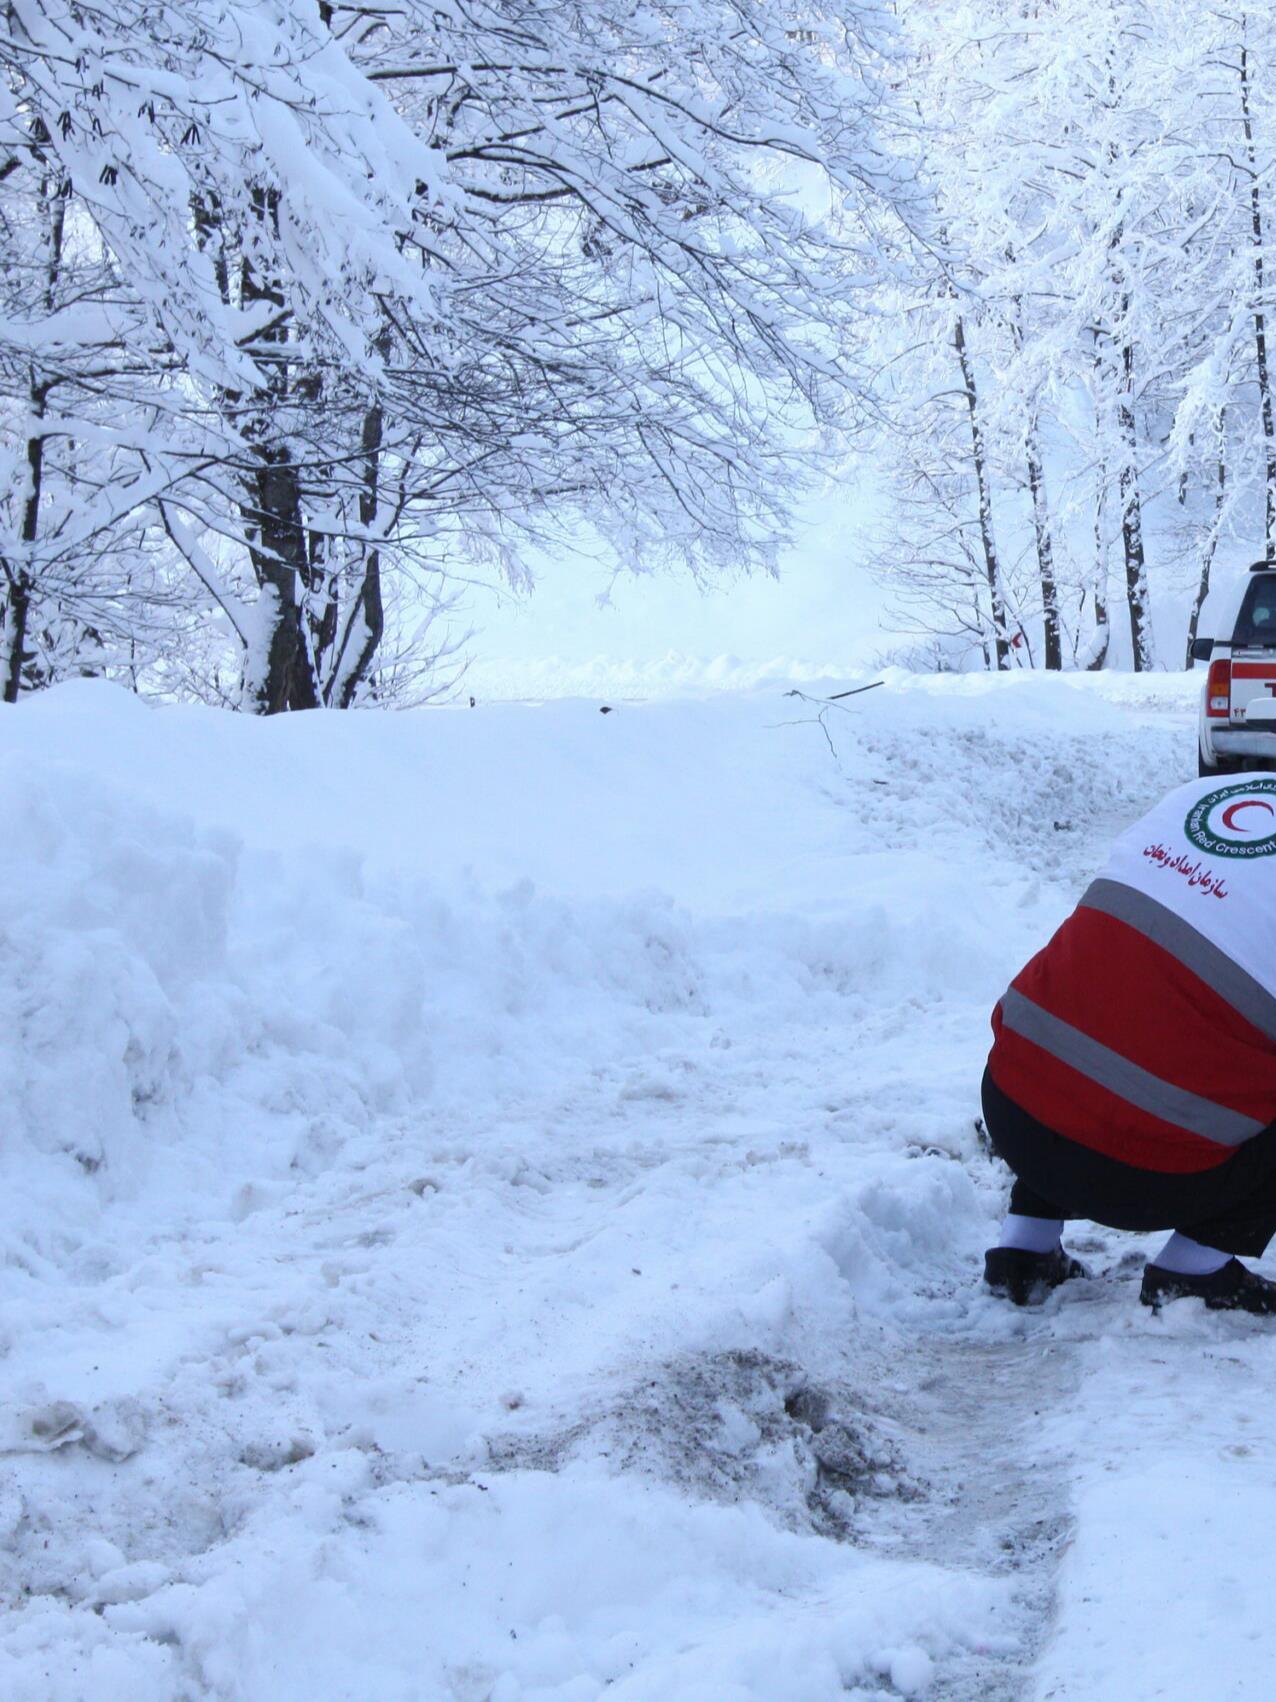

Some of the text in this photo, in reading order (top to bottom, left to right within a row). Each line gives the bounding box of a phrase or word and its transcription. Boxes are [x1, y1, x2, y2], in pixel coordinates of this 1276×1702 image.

[1190, 804, 1210, 832] Iranian
[1193, 831, 1217, 848] Red
[1169, 855, 1202, 877] امداد
[1188, 870, 1228, 899] سازمان
